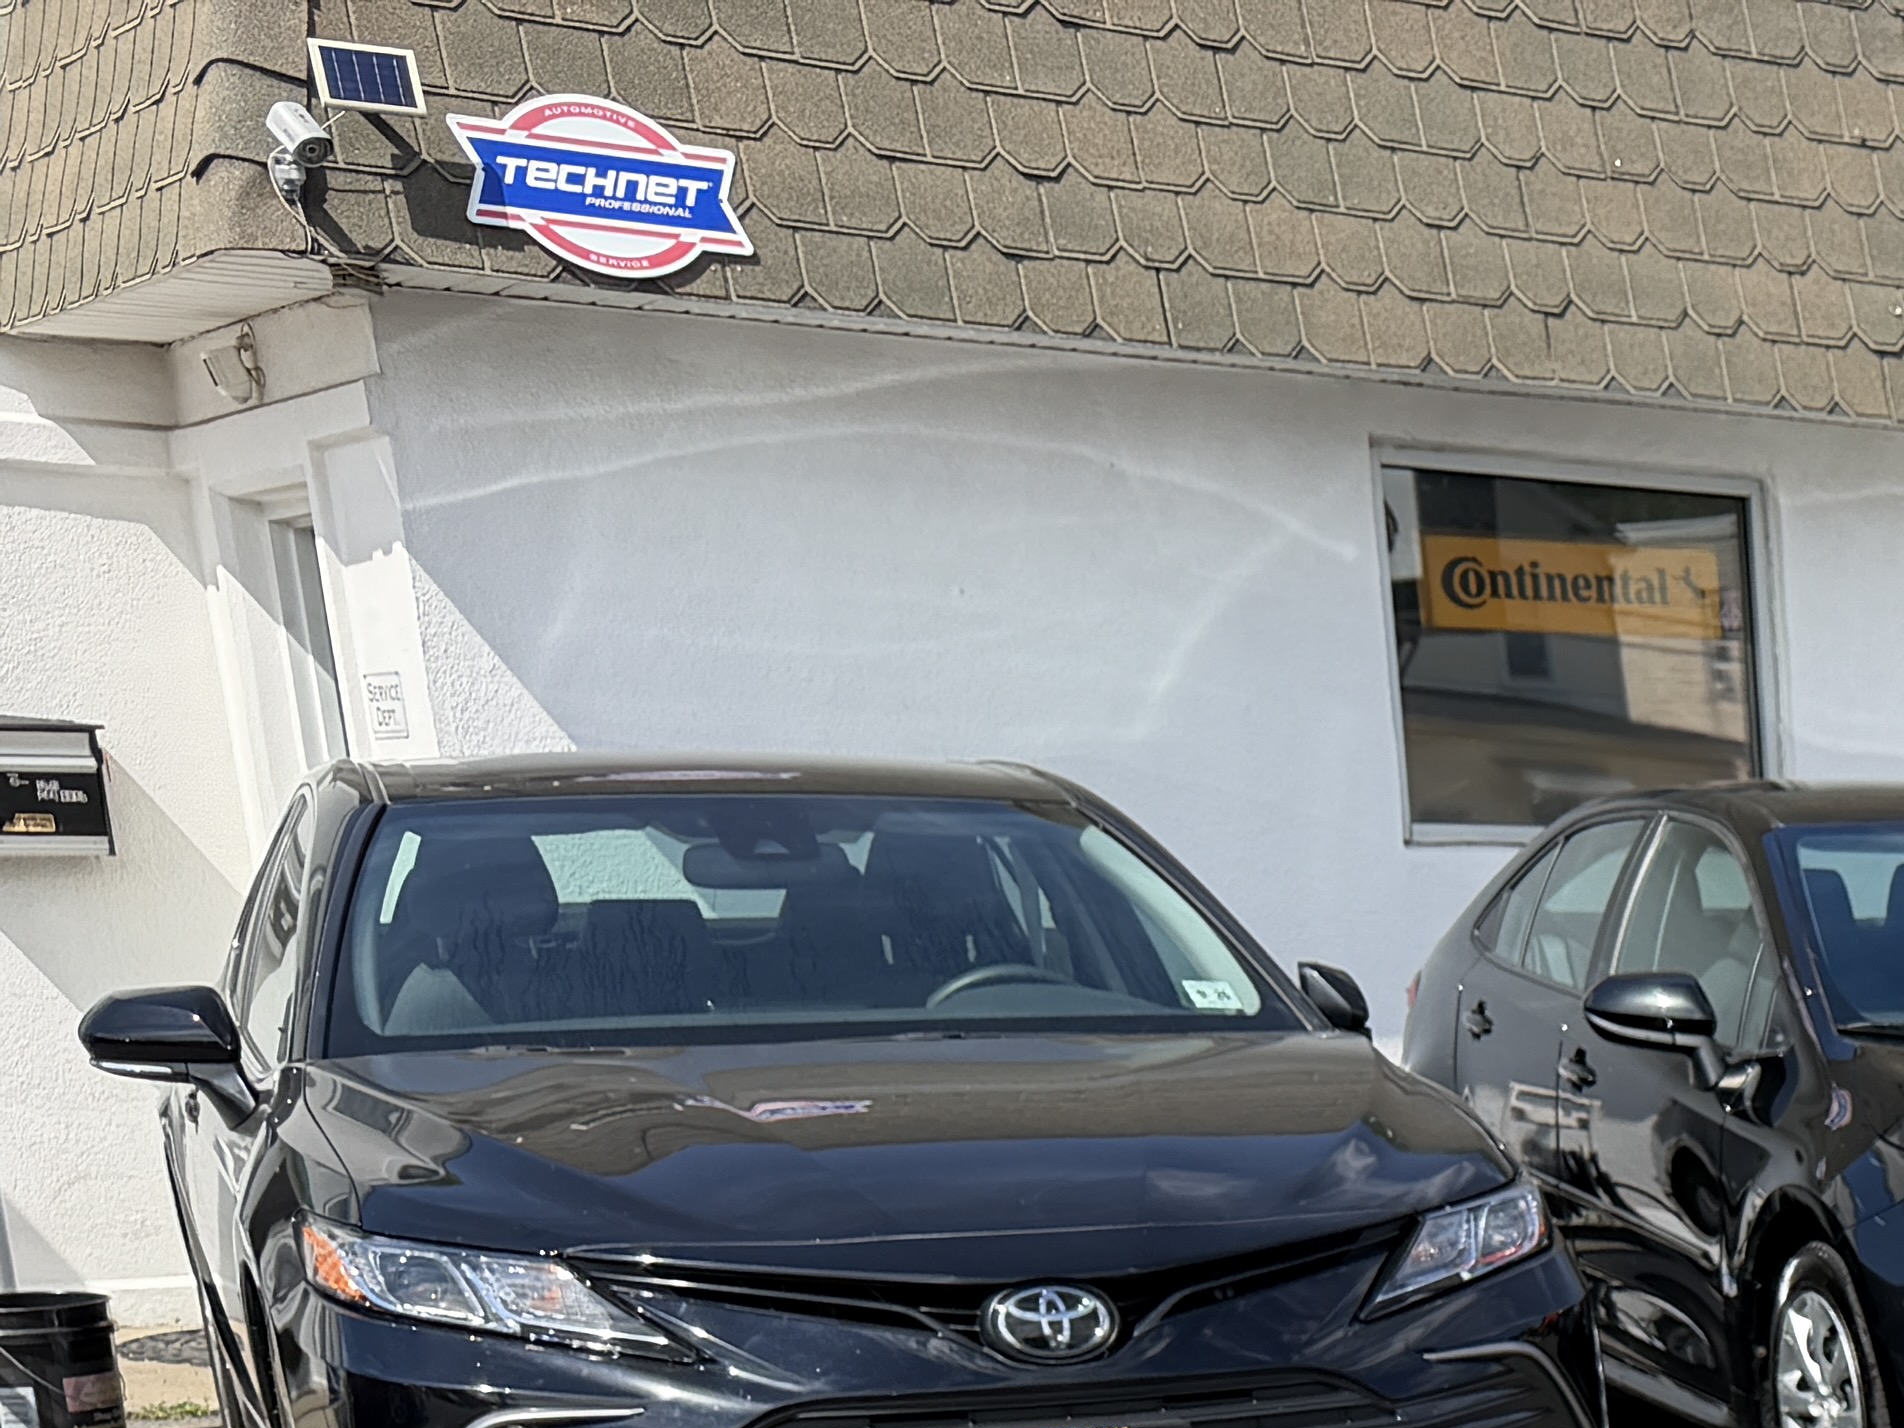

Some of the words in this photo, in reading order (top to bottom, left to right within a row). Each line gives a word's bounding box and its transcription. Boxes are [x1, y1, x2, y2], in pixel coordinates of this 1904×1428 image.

[543, 104, 637, 130] AUTOMOTIVE
[496, 155, 709, 208] TECHNET
[585, 197, 693, 219] PROFESSIONAL
[588, 253, 650, 268] SERVICE
[1441, 555, 1671, 610] Continental
